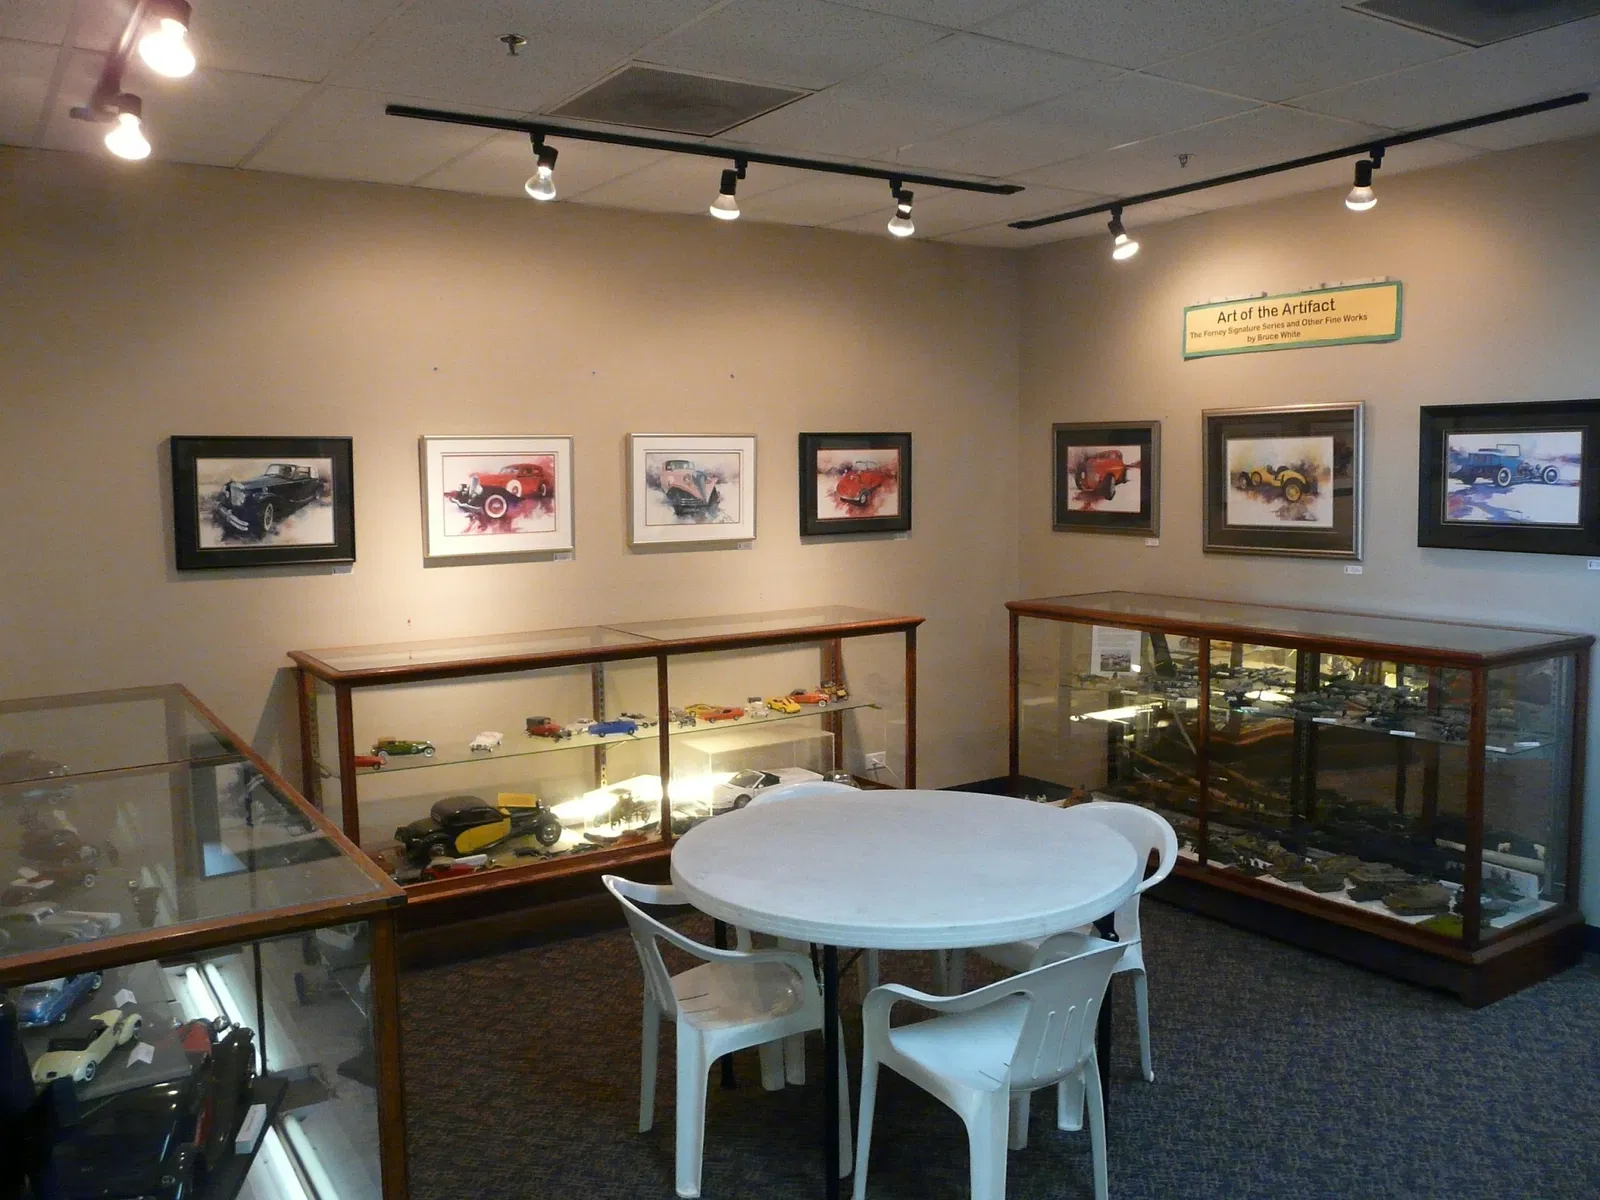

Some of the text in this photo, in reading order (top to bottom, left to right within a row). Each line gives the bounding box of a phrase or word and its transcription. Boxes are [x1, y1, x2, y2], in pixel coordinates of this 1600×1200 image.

[1217, 298, 1336, 324] Art of the Artifact
[1190, 331, 1202, 339] The
[1228, 324, 1260, 335] Signature
[1262, 321, 1285, 330] Series
[1286, 319, 1300, 328] and
[1301, 317, 1323, 327] Other
[1325, 315, 1342, 325] Fine
[1343, 313, 1368, 323] Works
[1247, 330, 1301, 343] by Bruce White
